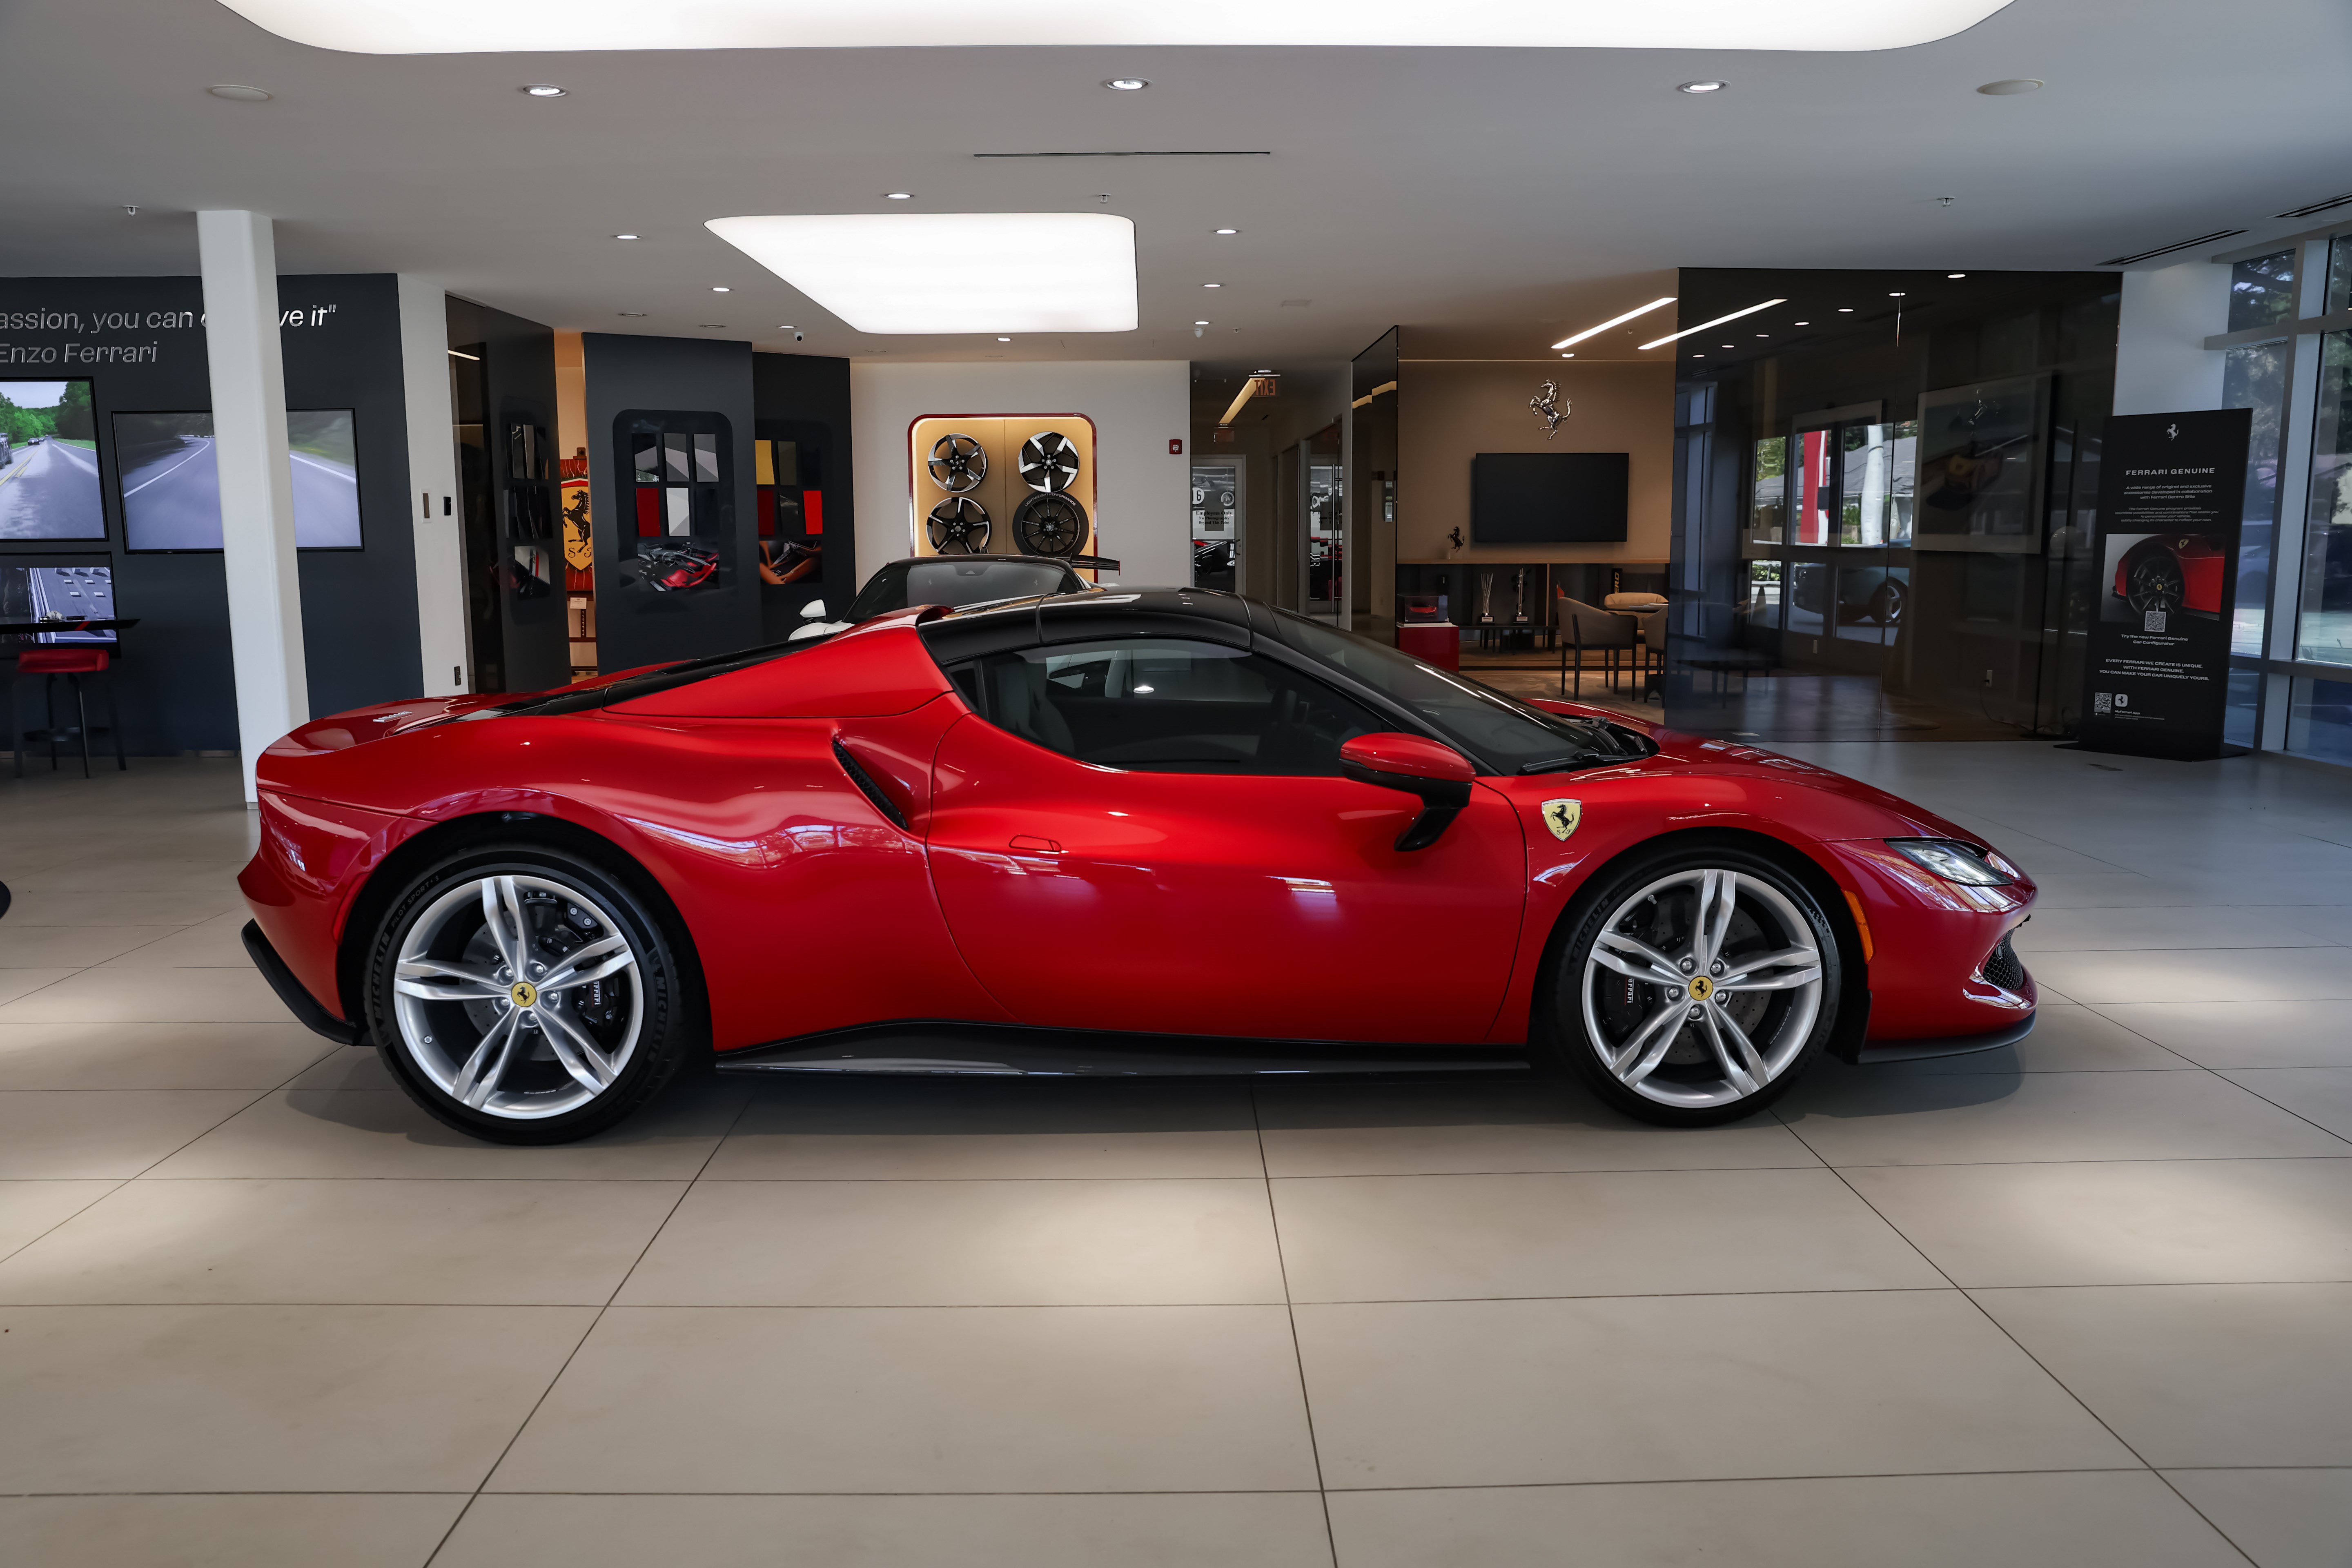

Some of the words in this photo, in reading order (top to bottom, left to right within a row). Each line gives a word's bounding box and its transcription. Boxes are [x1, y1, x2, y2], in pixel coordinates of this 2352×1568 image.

[91, 313, 139, 333] you
[147, 312, 193, 328] can
[312, 305, 336, 326] it"
[0, 344, 56, 363] Enzo
[65, 341, 157, 363] Ferrari
[1024, 493, 1048, 507] LIGHTWEIGHT
[1049, 493, 1076, 506] PERFORMANCE
[568, 547, 576, 558] S
[1573, 898, 1610, 958] MICHELIN
[372, 931, 391, 1020] MICHELIN
[391, 905, 407, 928] PILOT
[407, 881, 430, 905] SPORT
[1627, 978, 1635, 1003] errari
[647, 976, 668, 1063] MICHELIN
